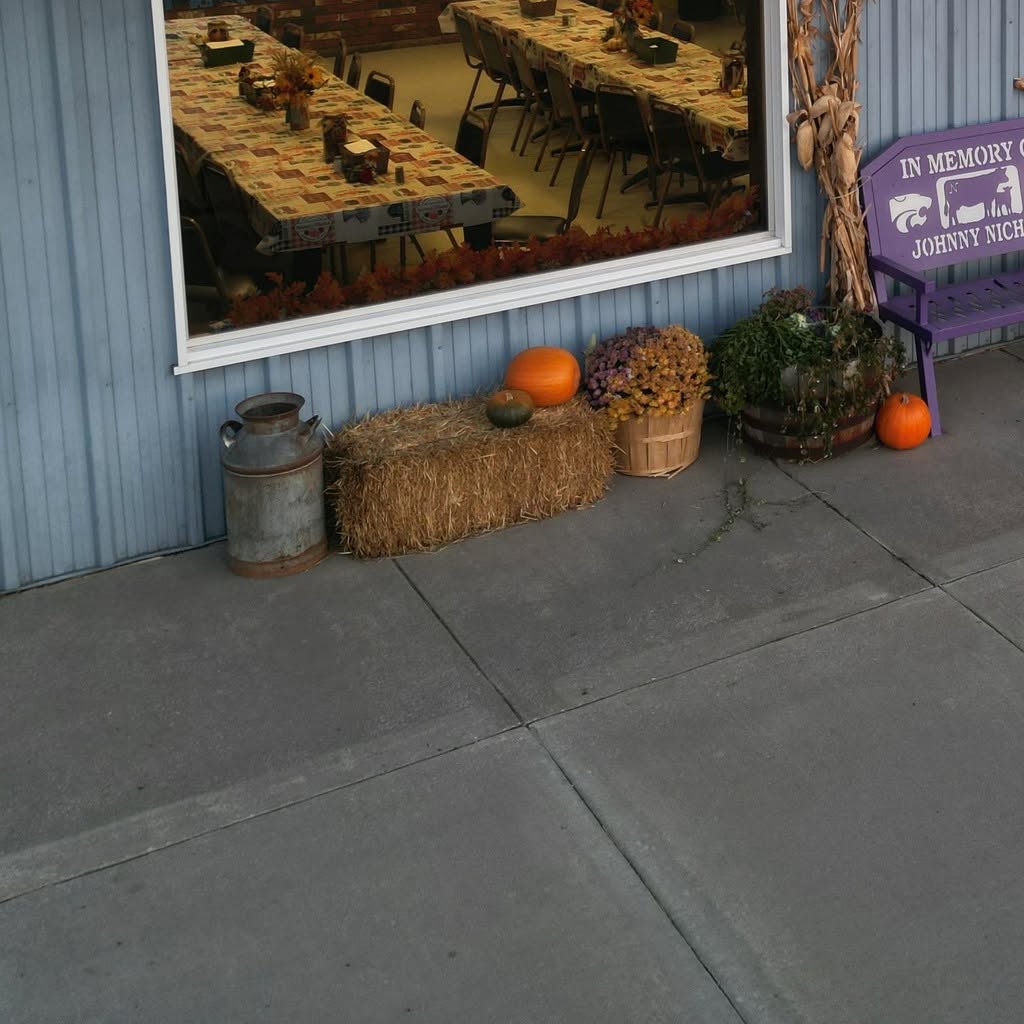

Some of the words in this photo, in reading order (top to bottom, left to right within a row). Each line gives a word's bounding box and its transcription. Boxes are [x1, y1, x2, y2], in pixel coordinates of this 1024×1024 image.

[900, 156, 922, 179] IN
[927, 141, 1014, 175] MEMORY
[912, 227, 980, 259] JOHNNY
